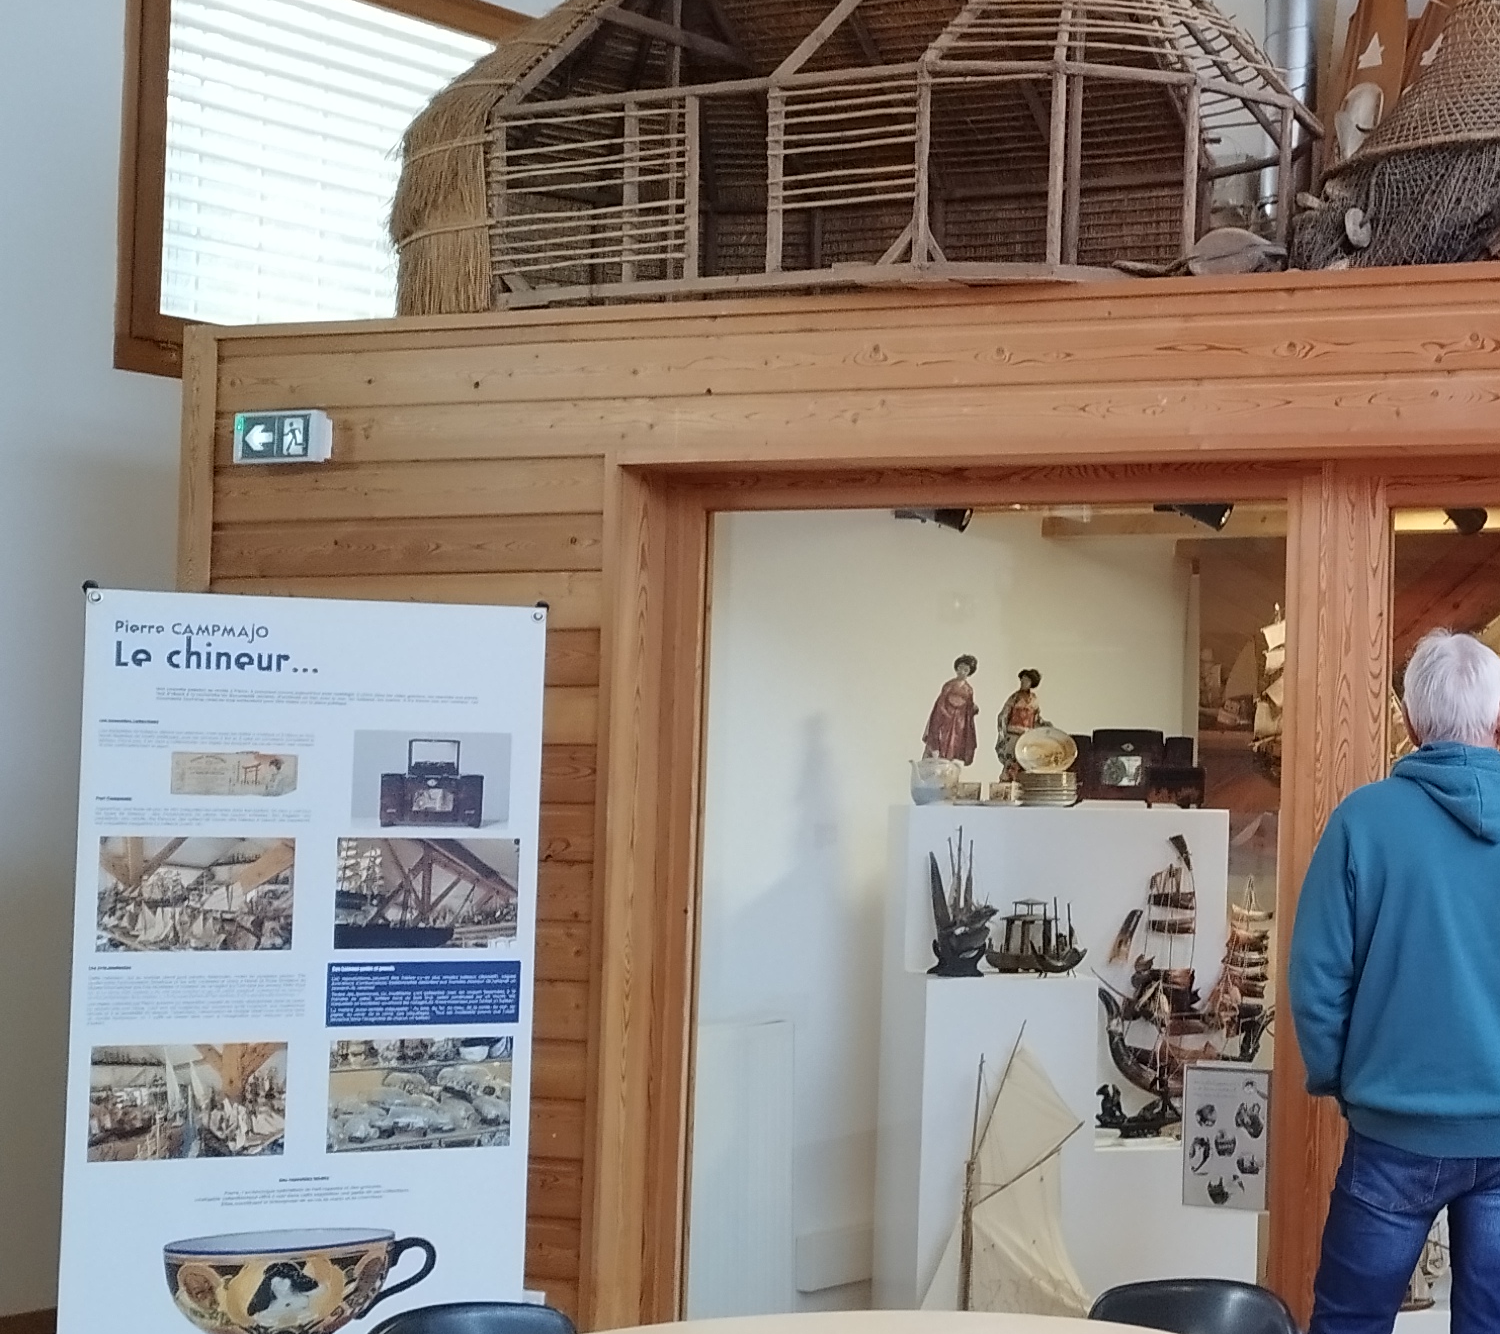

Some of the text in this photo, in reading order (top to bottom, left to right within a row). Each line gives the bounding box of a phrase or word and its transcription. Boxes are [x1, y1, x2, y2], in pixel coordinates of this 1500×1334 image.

[115, 620, 269, 644] Pierre CAMPMAJO
[115, 640, 152, 668] Le
